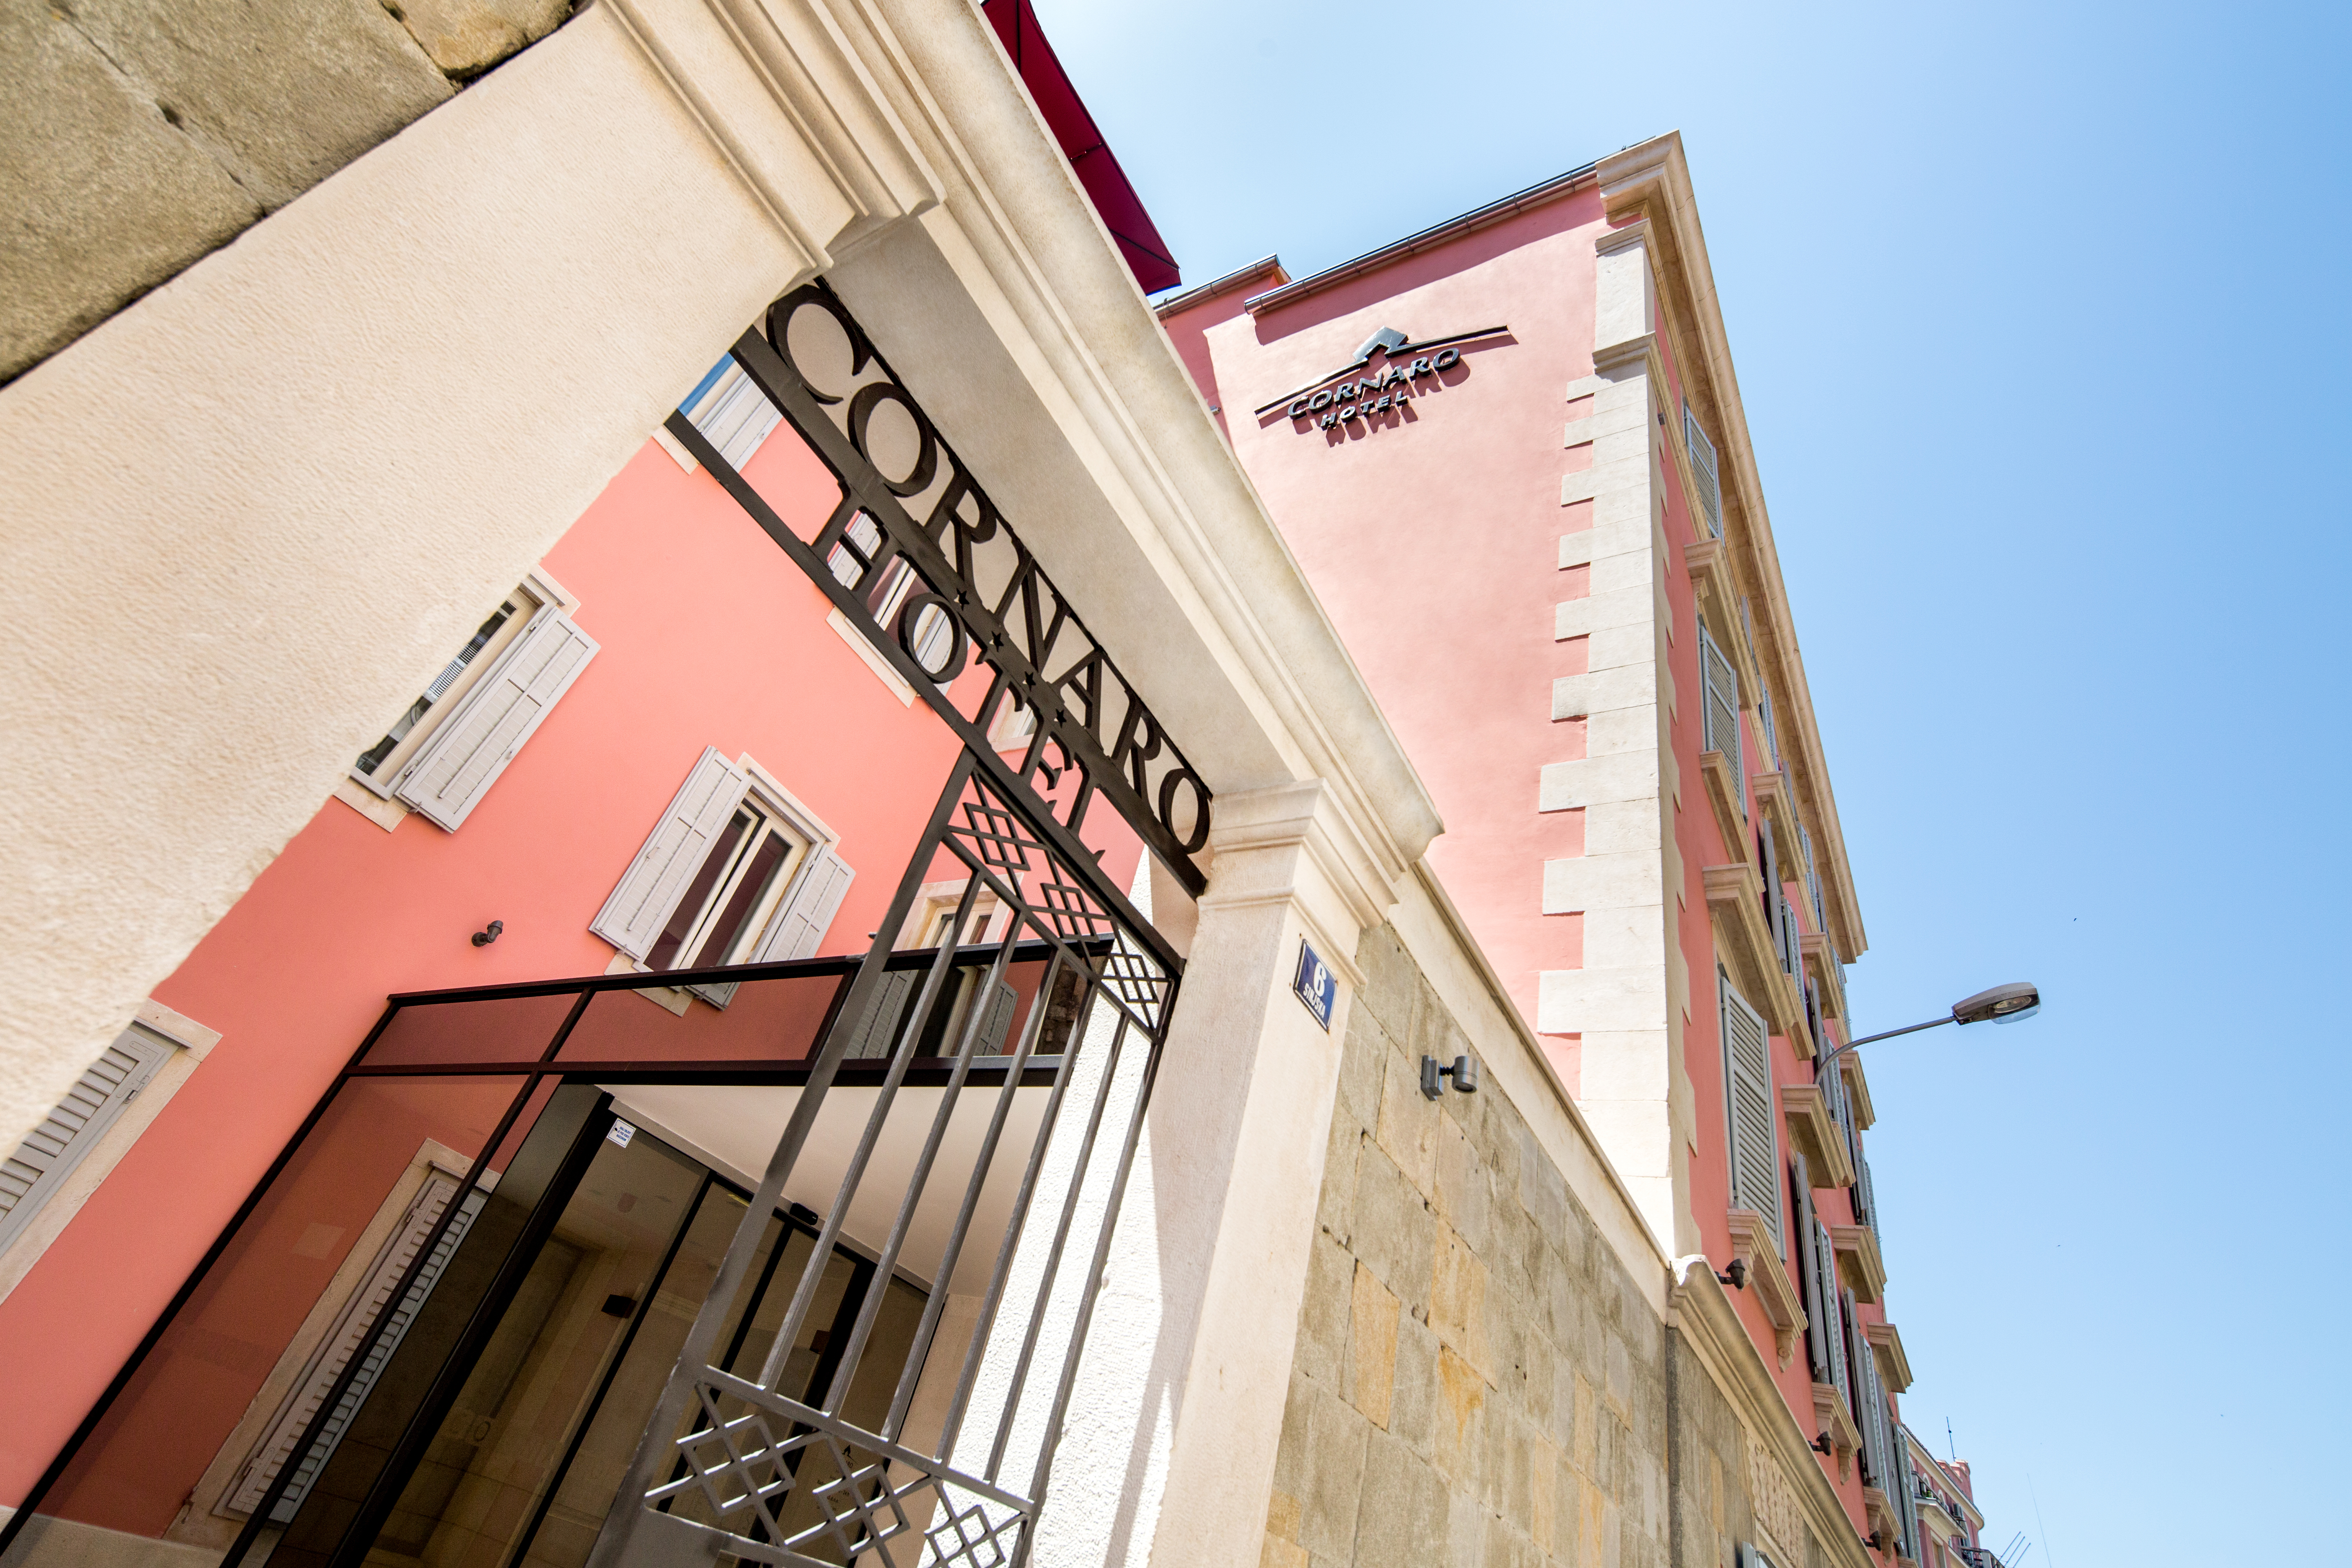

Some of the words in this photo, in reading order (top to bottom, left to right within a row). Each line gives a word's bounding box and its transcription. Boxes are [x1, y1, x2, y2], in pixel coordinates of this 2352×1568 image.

[1288, 348, 1460, 419] CORNARO
[1321, 391, 1408, 430] HOTEL
[766, 285, 1211, 855] CORNARO
[802, 478, 1105, 866] HOTEL
[1303, 983, 1326, 1018] SINJSKA
[1314, 962, 1327, 997] 6
